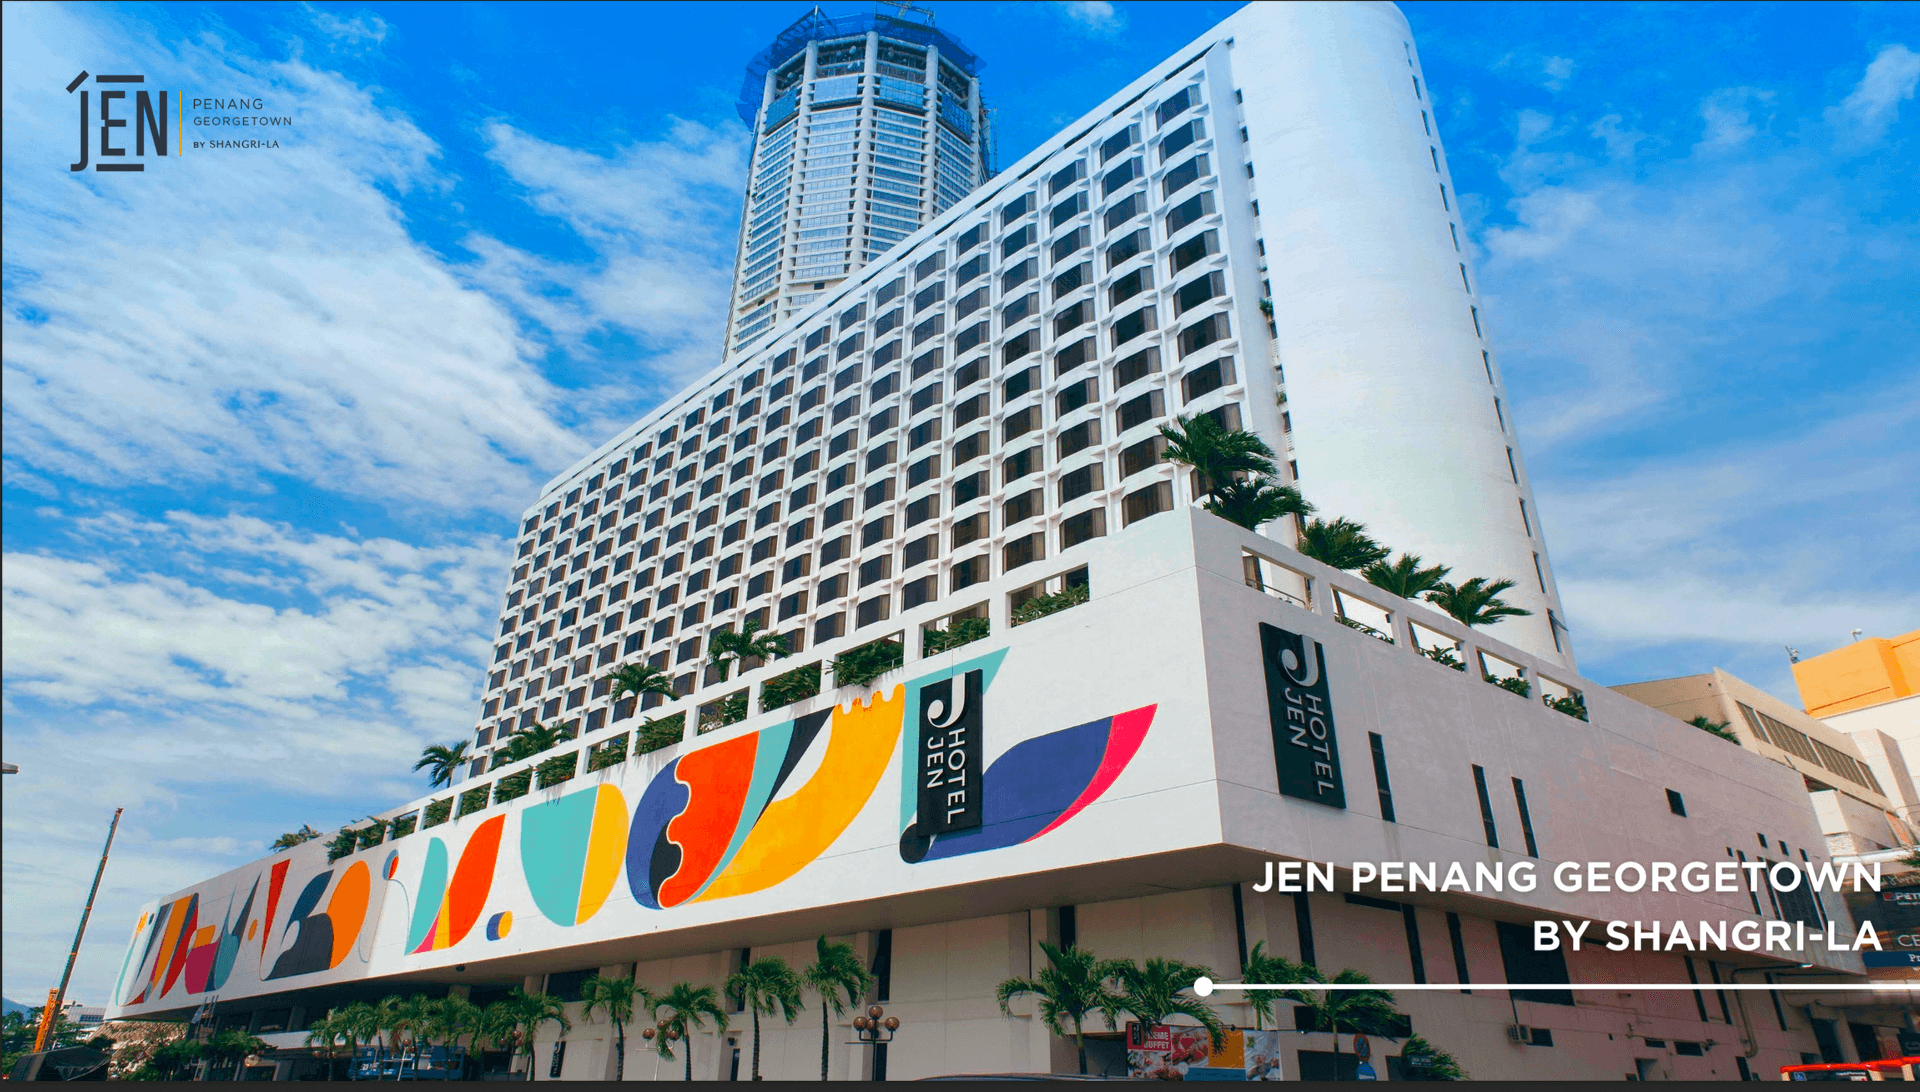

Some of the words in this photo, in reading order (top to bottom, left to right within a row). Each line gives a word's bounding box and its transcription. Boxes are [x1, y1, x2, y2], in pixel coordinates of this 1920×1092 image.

[1284, 687, 1309, 748] JEN
[1305, 693, 1334, 795] HOTEL
[927, 736, 944, 789] JEN
[947, 727, 966, 825] HOTEL
